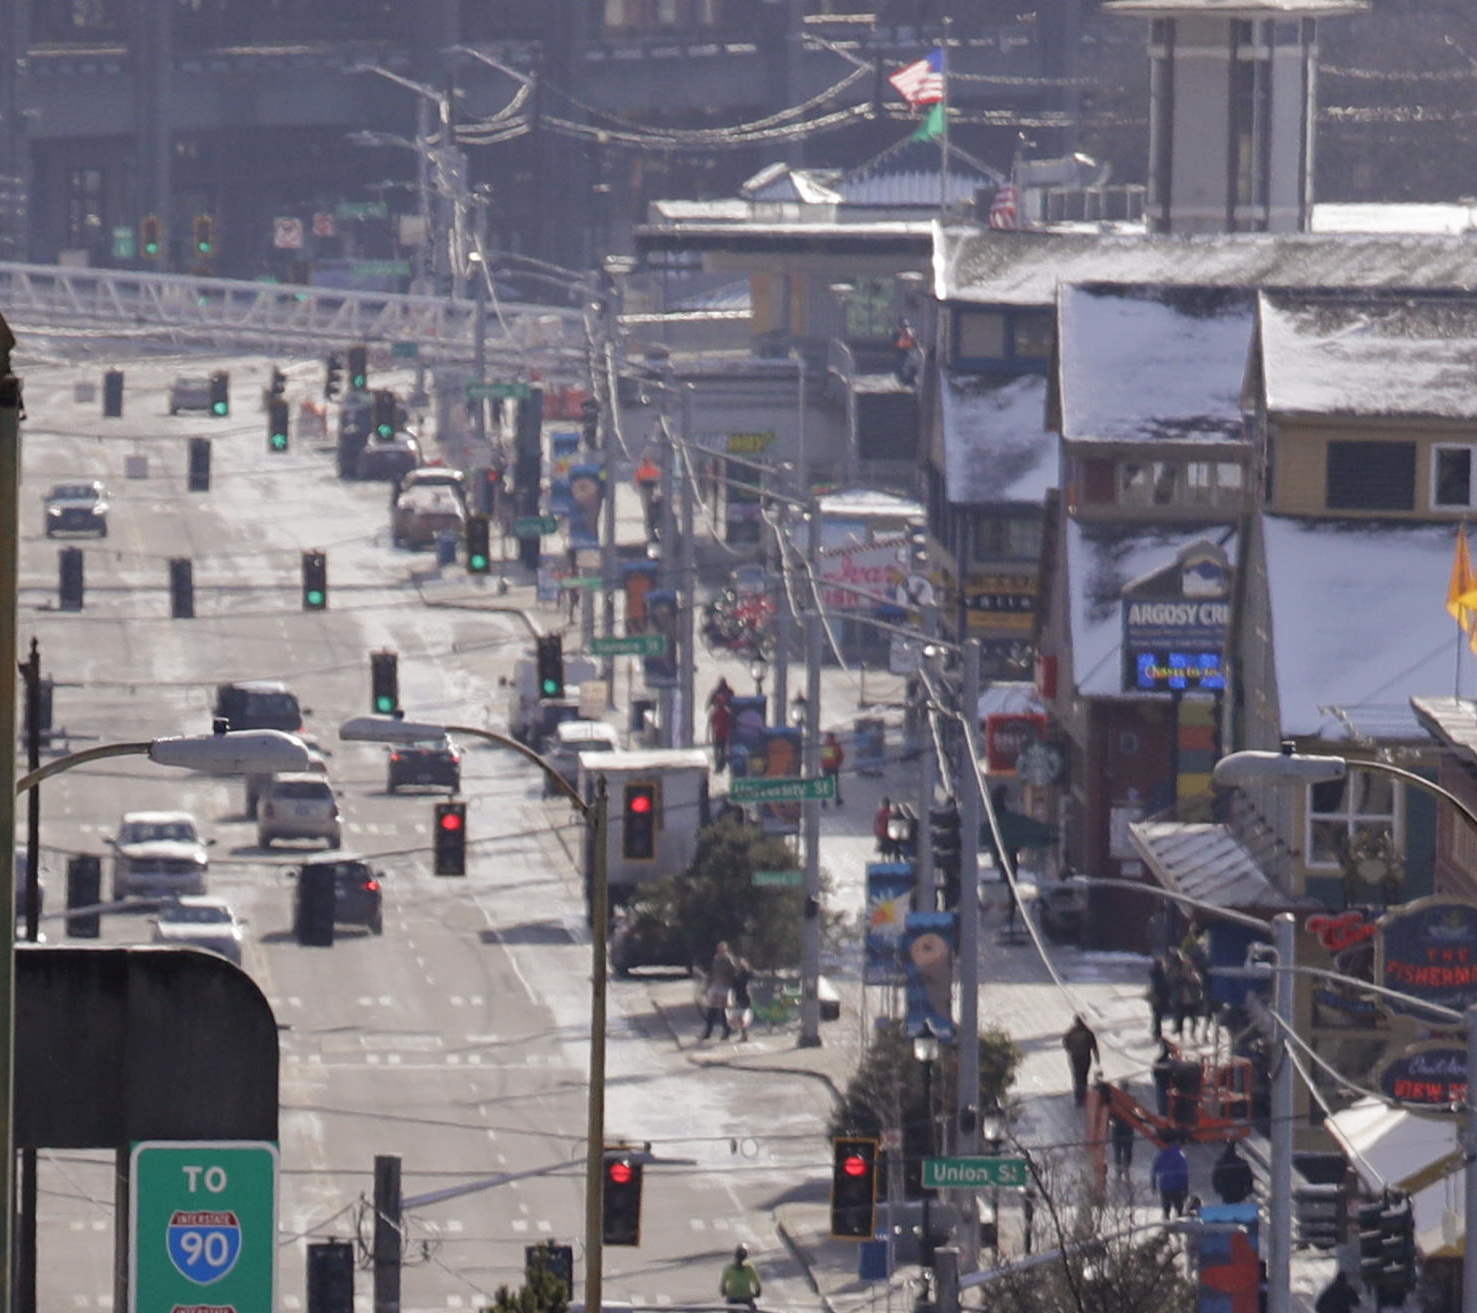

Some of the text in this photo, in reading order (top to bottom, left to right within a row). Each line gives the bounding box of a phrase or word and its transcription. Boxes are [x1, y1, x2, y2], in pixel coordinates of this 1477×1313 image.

[1128, 603, 1198, 625] ARGOSY
[732, 779, 831, 800] University St
[1426, 947, 1470, 963] THE
[182, 1165, 228, 1194] TO
[933, 1163, 1019, 1183] Union St
[175, 1211, 233, 1226] INTERSTATE
[180, 1231, 230, 1268] 90
